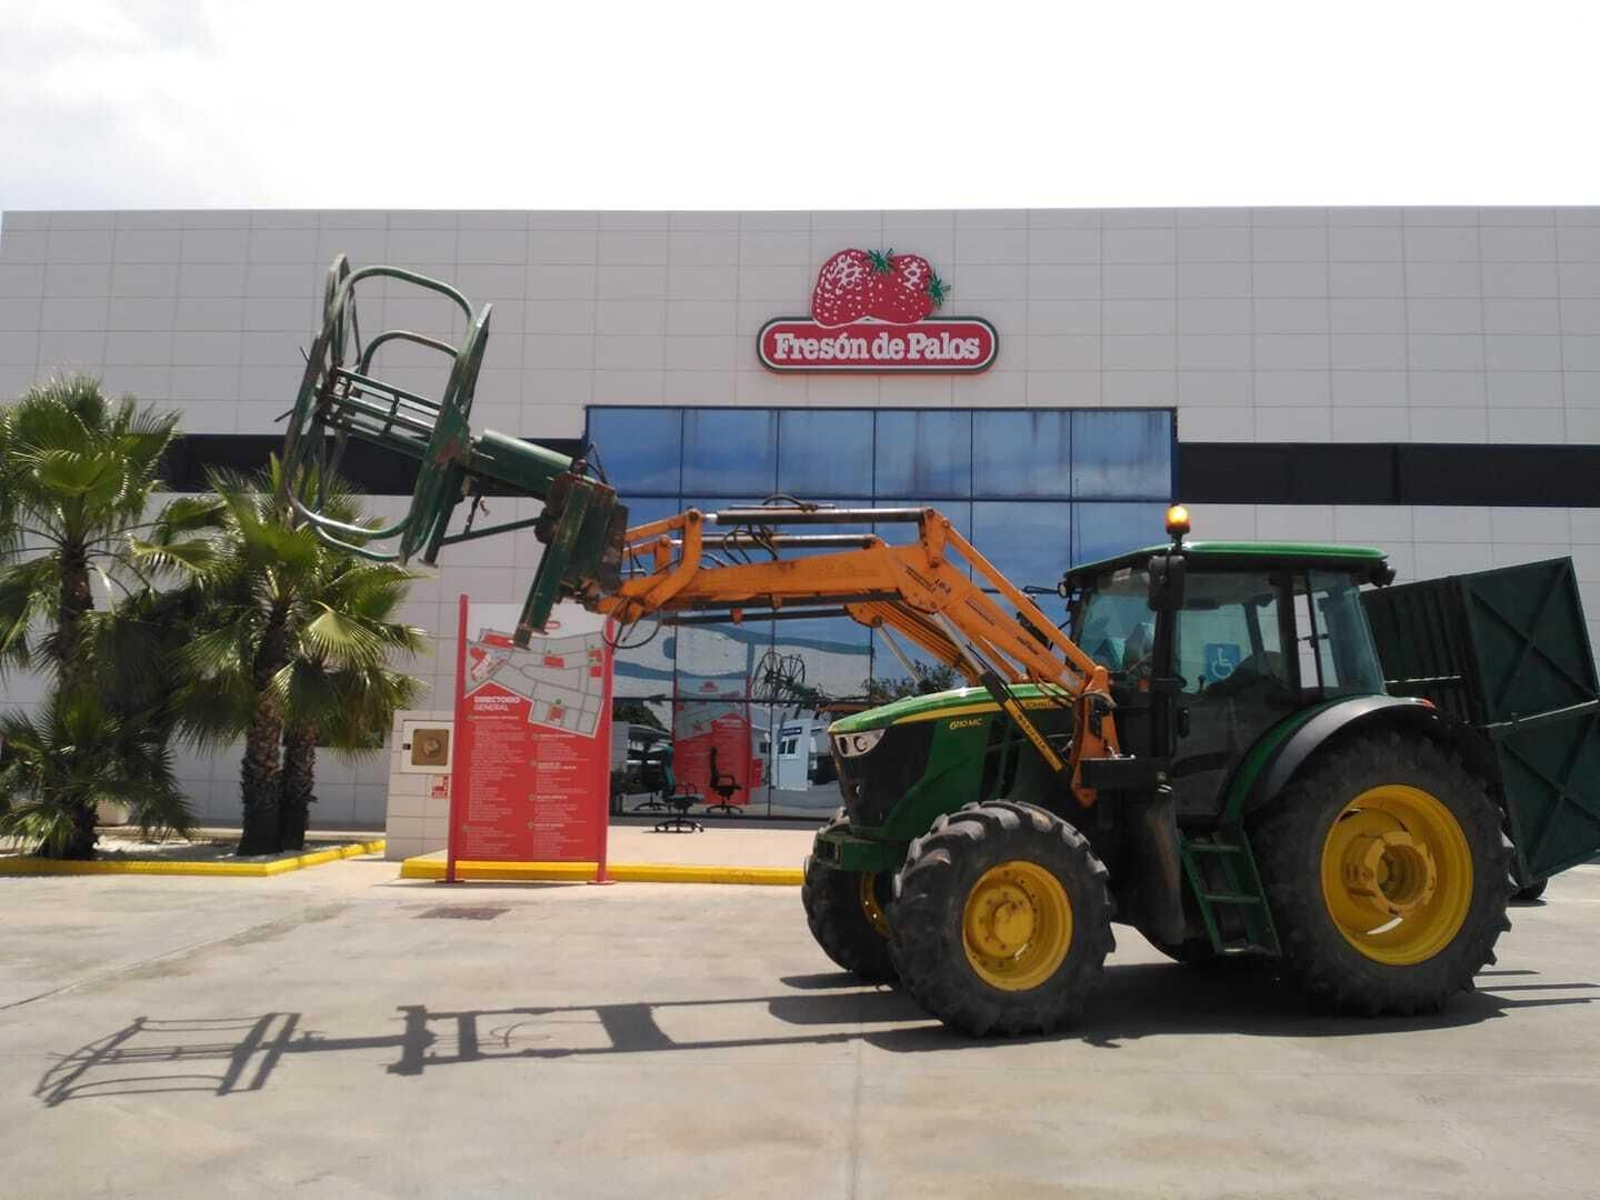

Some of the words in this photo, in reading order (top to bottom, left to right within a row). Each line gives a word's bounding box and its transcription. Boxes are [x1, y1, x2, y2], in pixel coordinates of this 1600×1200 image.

[773, 331, 870, 360] Fresón
[871, 332, 905, 360] de
[906, 332, 980, 360] Palos
